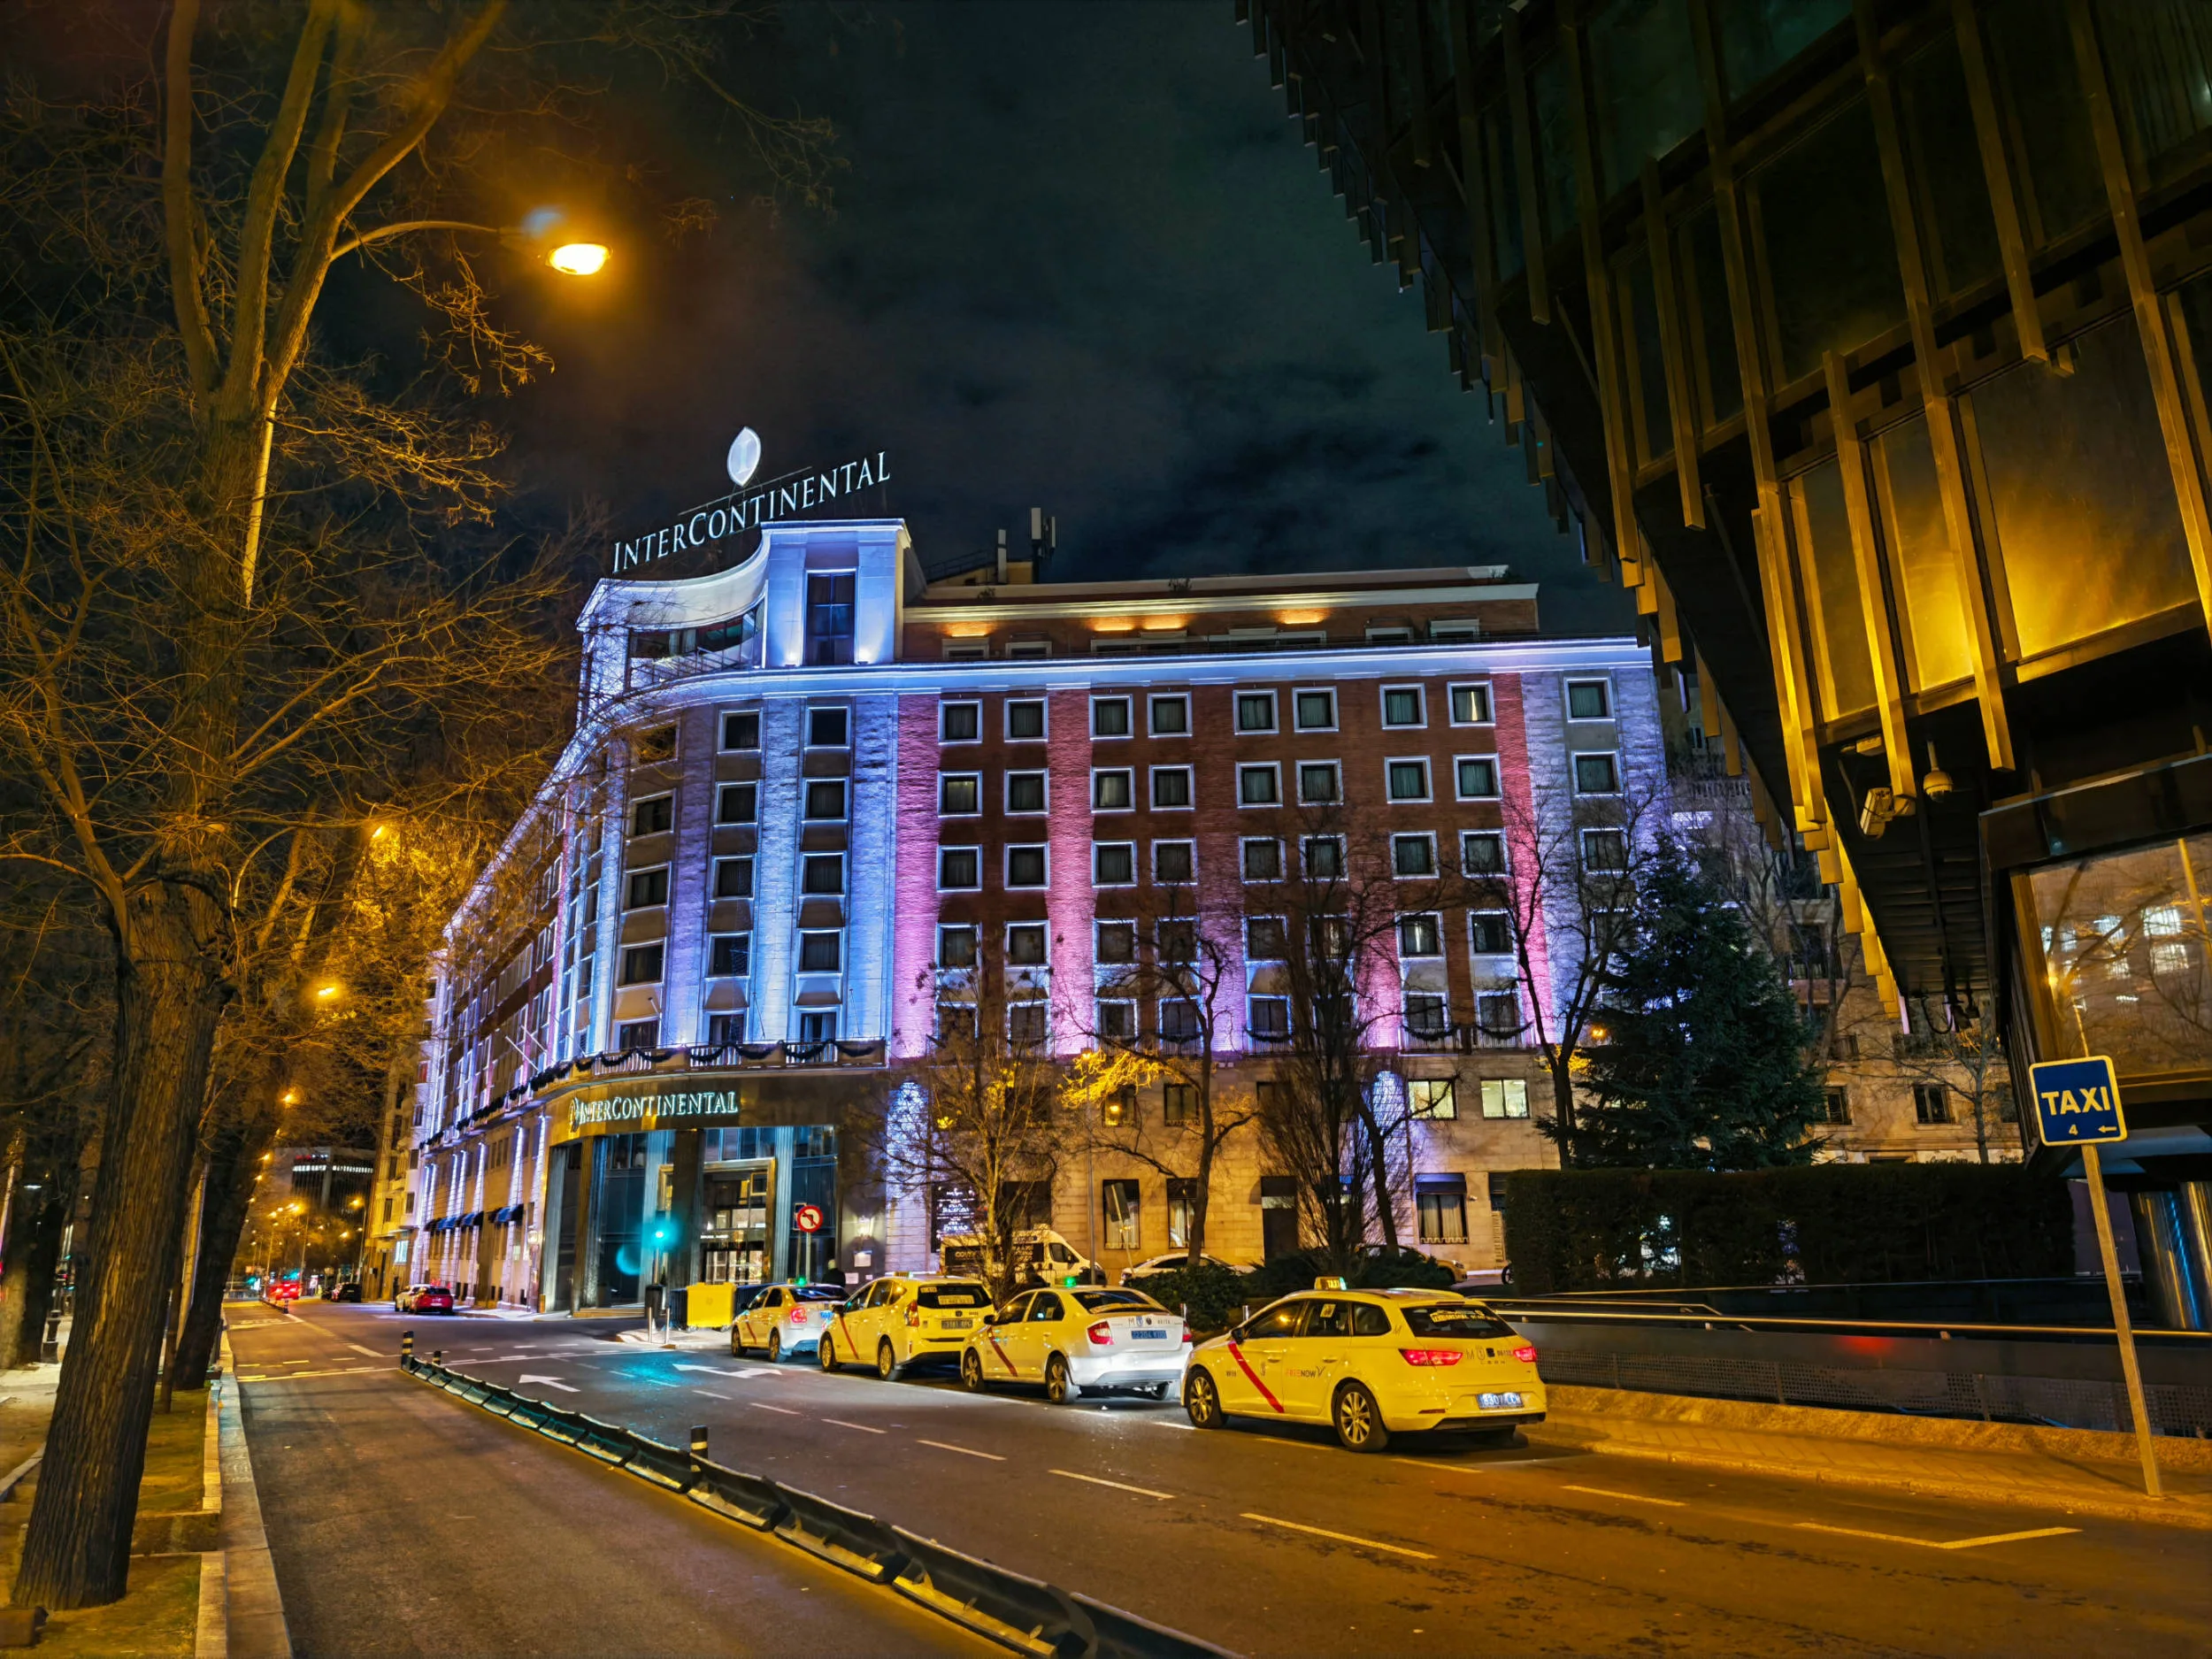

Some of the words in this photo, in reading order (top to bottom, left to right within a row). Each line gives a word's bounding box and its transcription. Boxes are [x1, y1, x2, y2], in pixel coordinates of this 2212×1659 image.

[612, 451, 890, 574] INTERCONTINENTAL
[579, 1091, 739, 1125] INTERCONTINENTAL
[2041, 1087, 2110, 1116] TAXI
[2069, 1125, 2078, 1135] 4
[1327, 1279, 1340, 1289] TAXI
